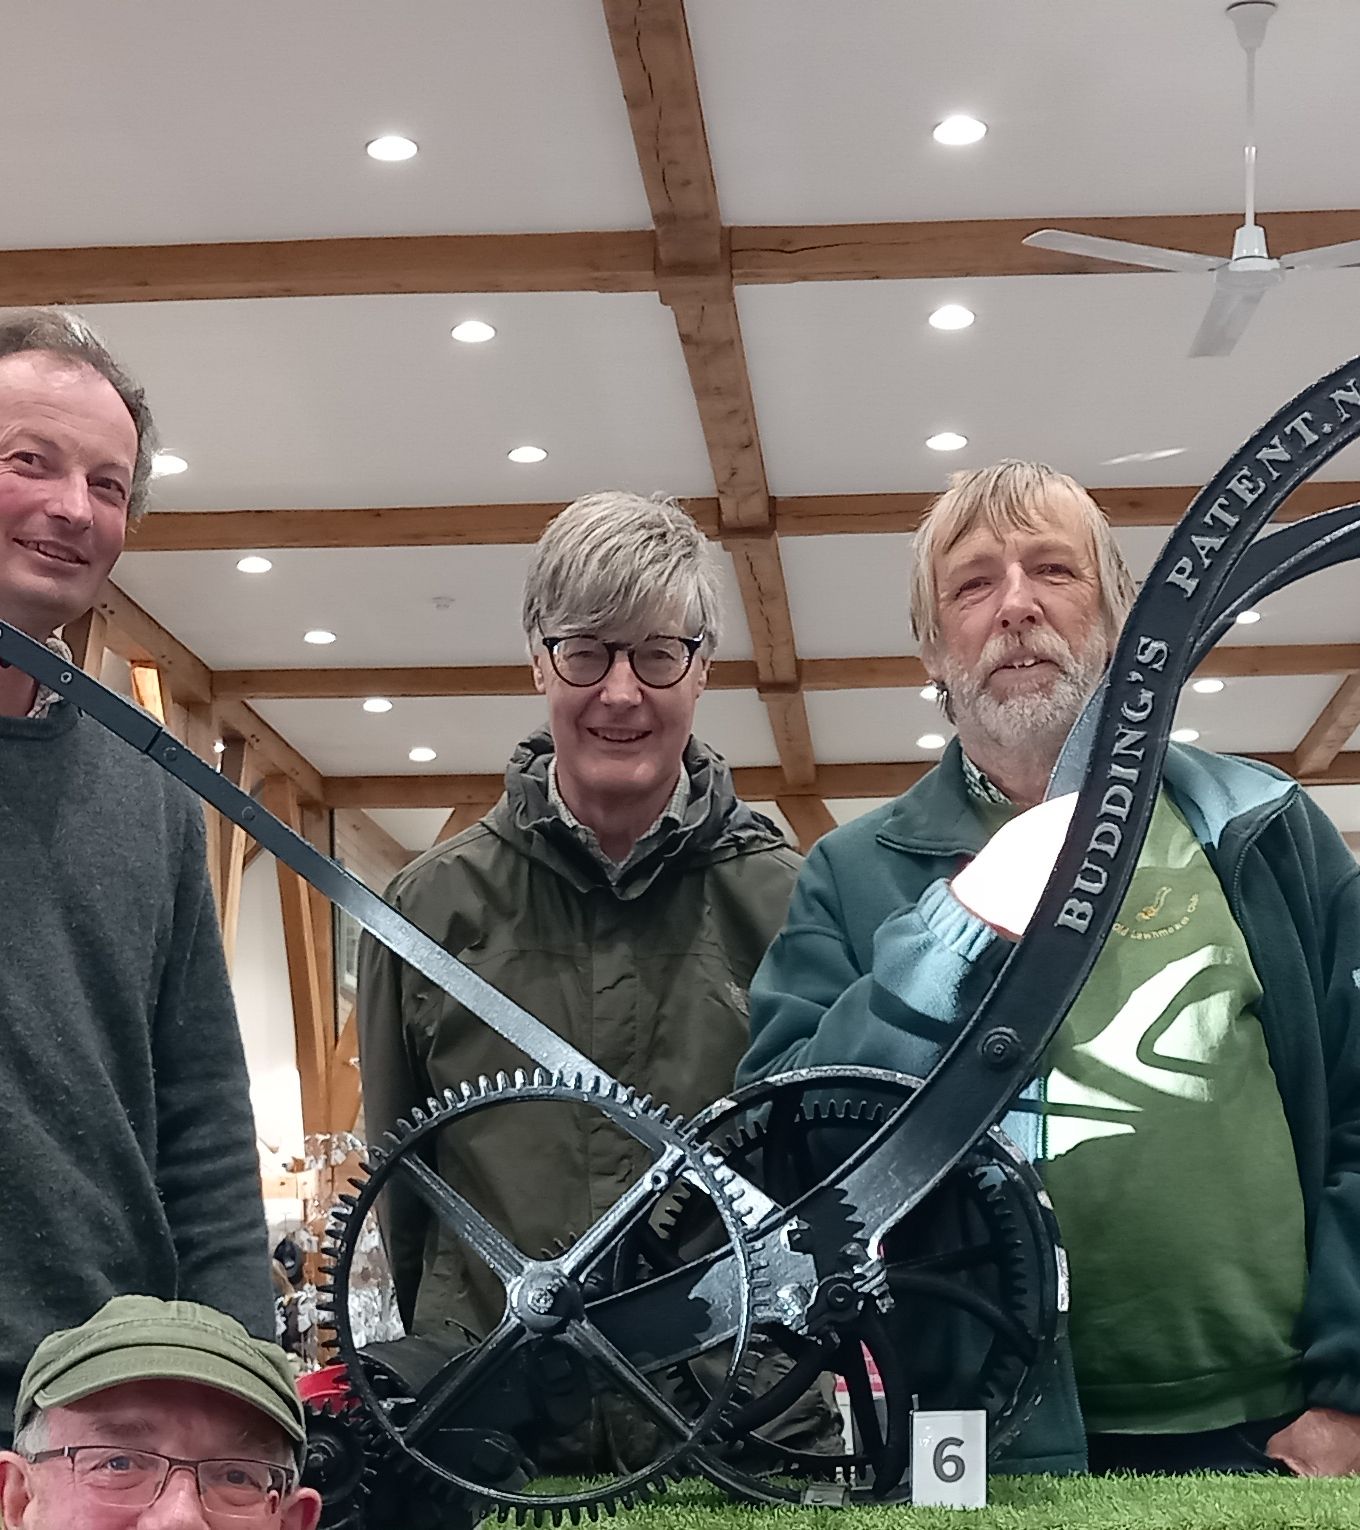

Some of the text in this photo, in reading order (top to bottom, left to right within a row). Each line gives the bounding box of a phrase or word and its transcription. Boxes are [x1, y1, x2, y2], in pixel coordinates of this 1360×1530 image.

[1054, 635, 1169, 934] BUDDING'S
[1112, 922, 1130, 937] Old
[933, 1436, 966, 1483] 6
